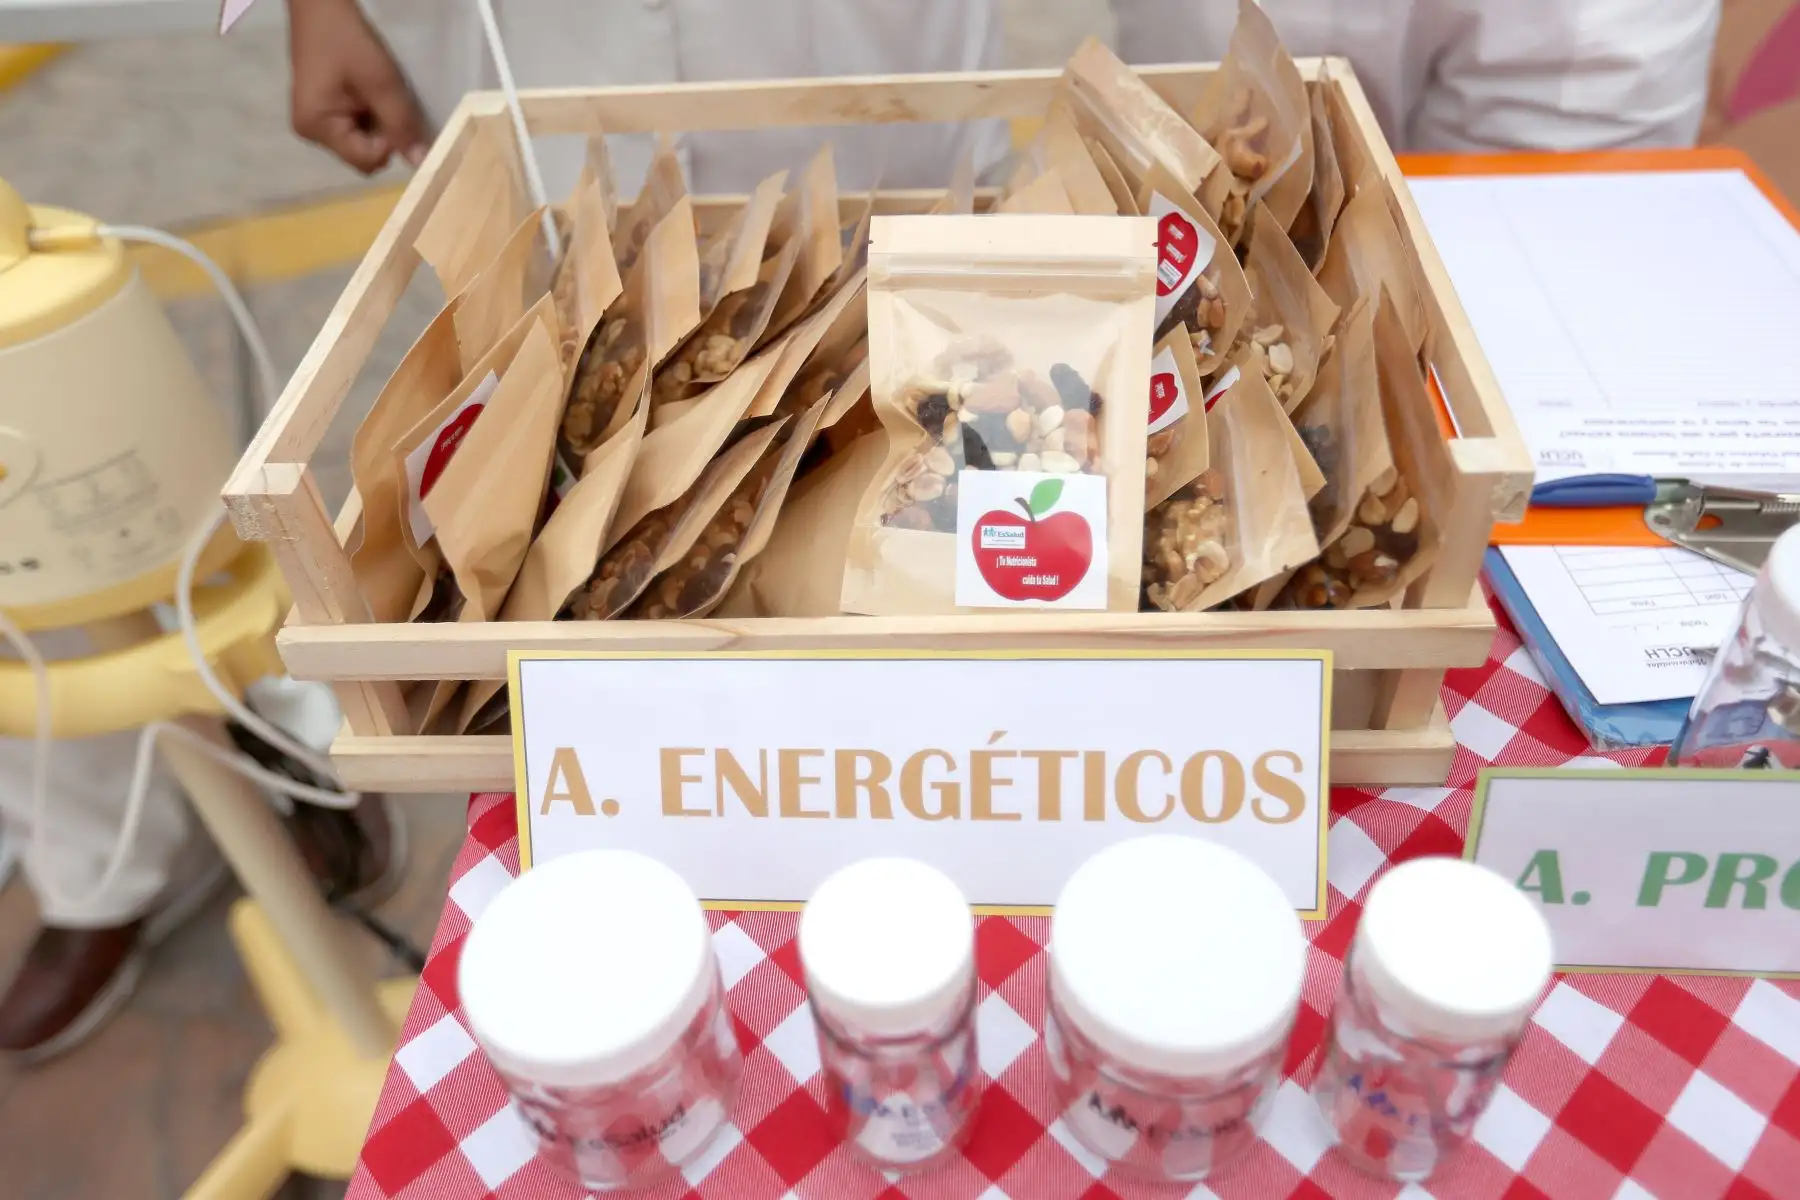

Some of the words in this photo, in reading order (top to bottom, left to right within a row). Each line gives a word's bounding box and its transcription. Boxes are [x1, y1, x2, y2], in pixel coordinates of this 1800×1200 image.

[1006, 556, 1037, 567] Nutricionista
[540, 746, 620, 818] A.
[659, 730, 1306, 824] ENERGÉTICOS
[1513, 849, 1592, 906] A.
